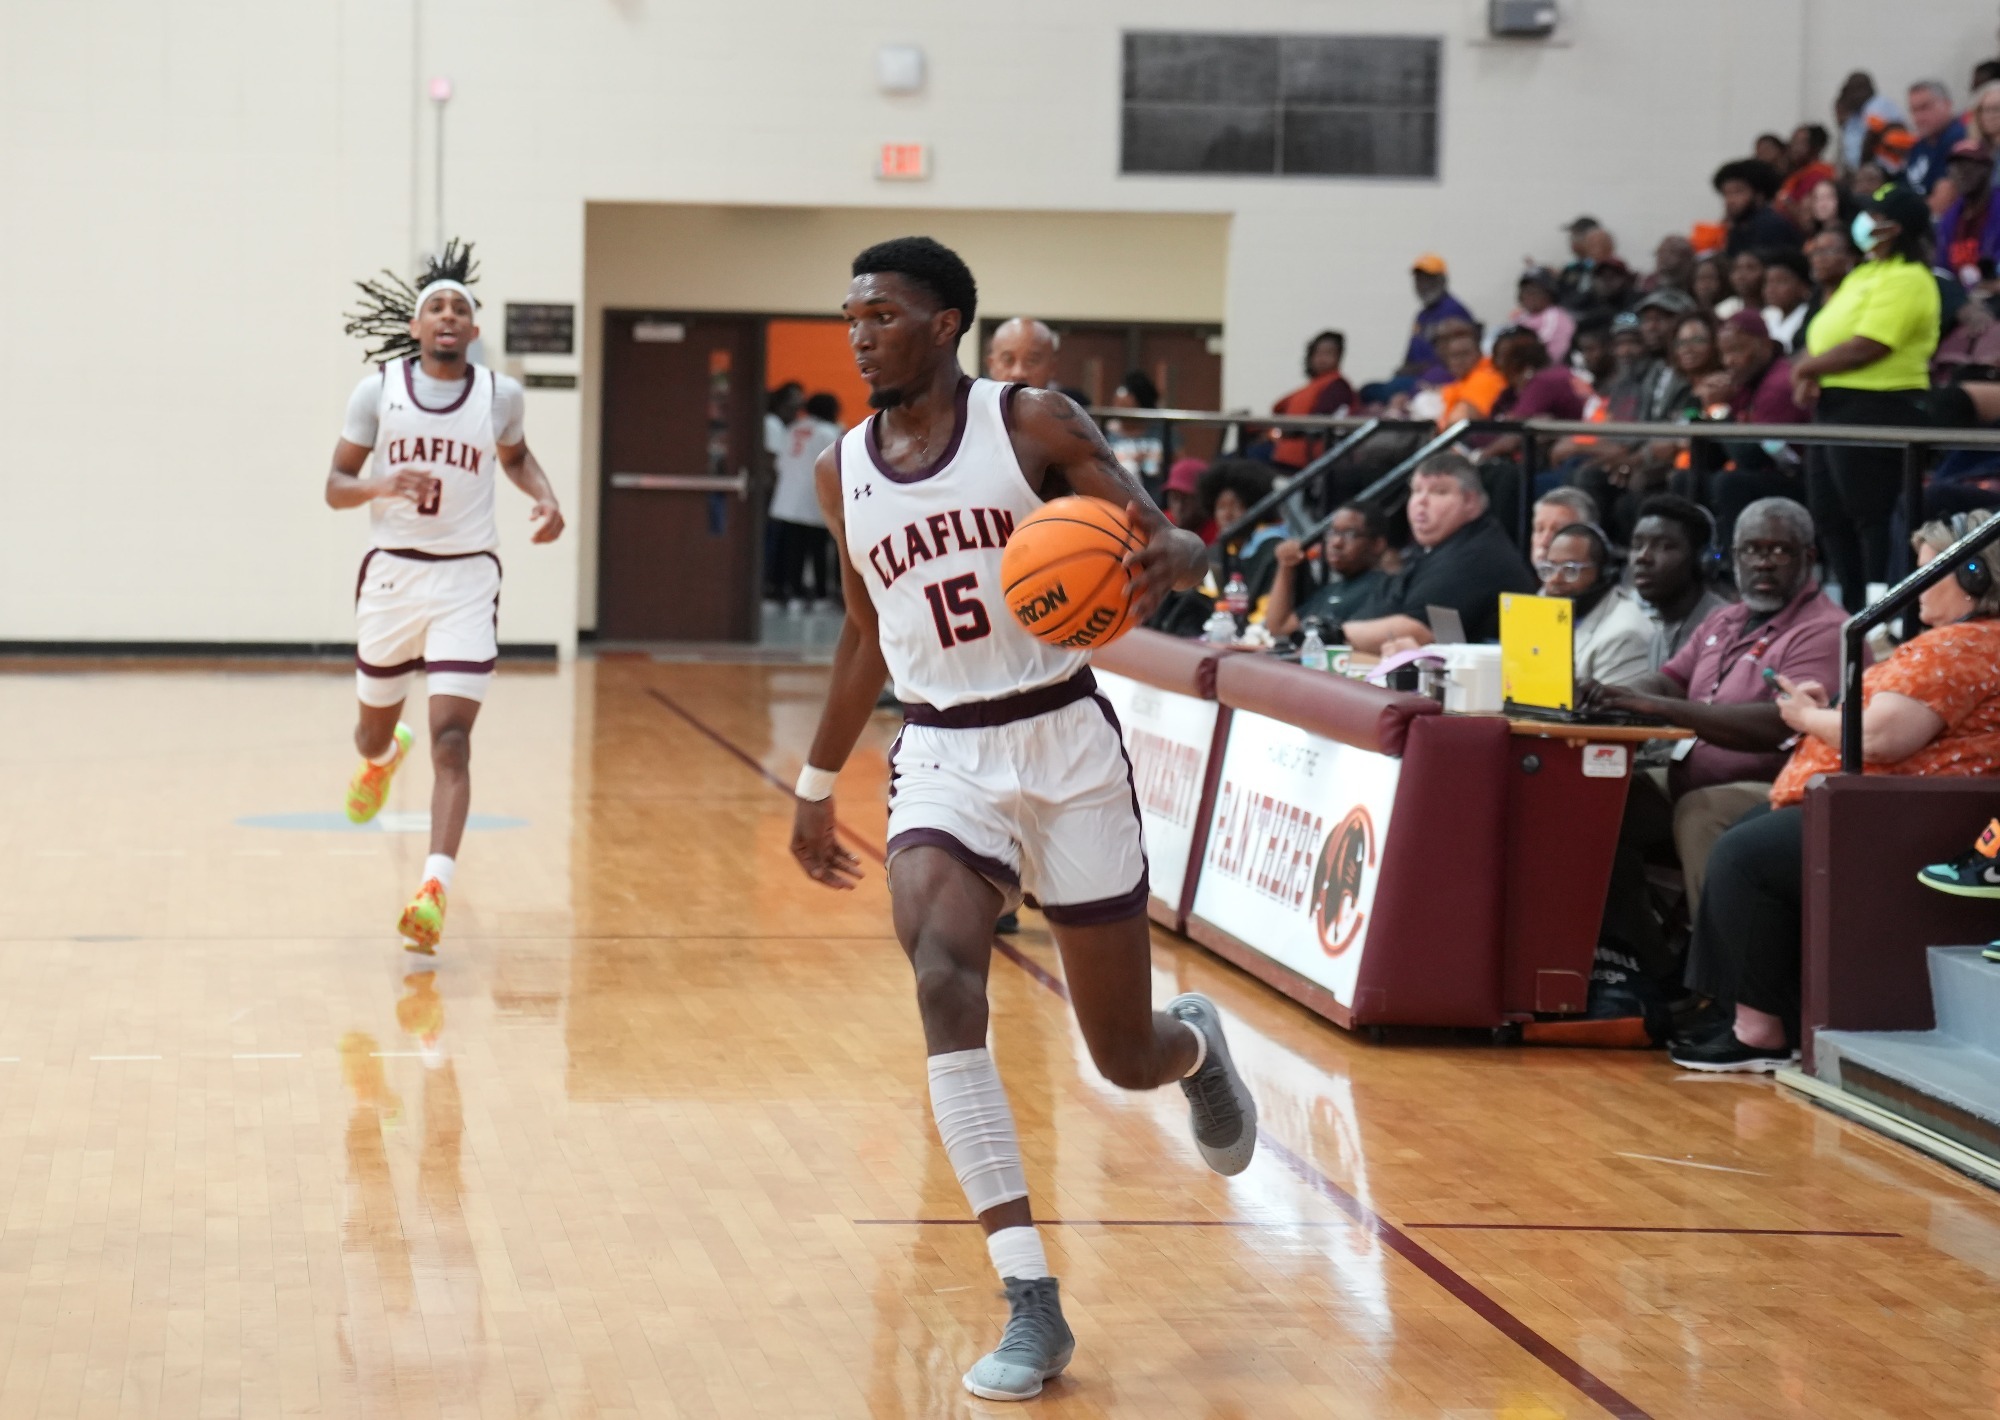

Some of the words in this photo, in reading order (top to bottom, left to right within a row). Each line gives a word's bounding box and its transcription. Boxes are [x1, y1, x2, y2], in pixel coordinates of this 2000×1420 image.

[388, 436, 482, 476] CLAFLIN
[869, 507, 1016, 590] CLAFLIN
[923, 571, 992, 650] 15
[1015, 579, 1070, 627] NCAA
[1209, 780, 1323, 912] PANTHERS
